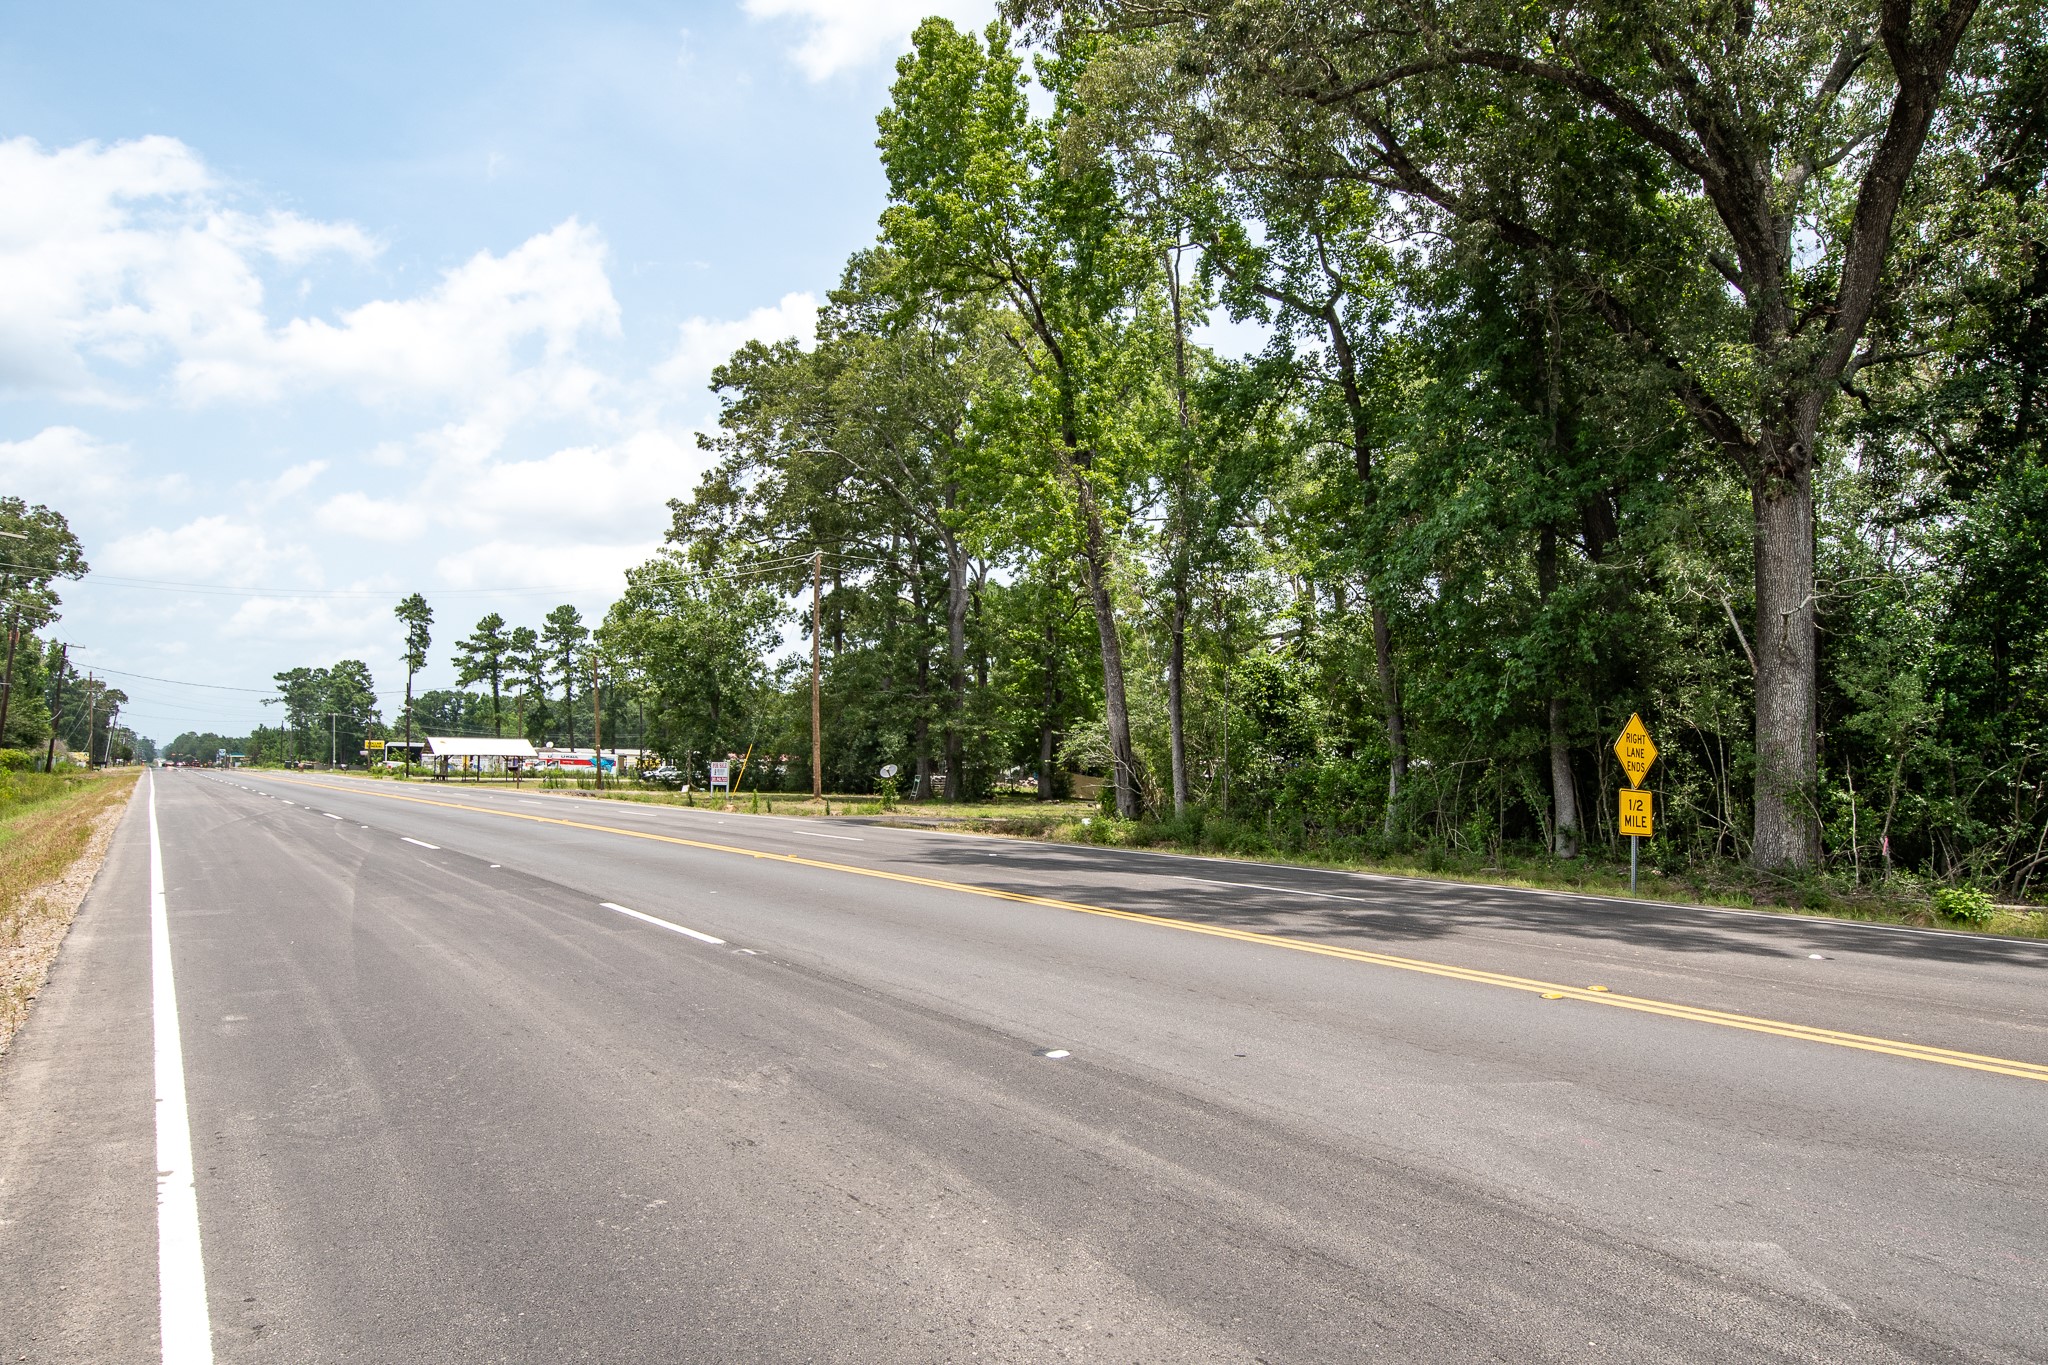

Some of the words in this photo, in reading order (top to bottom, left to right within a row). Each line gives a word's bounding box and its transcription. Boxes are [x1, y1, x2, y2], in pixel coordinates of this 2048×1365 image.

[1626, 733, 1645, 744] RIGHT
[1627, 747, 1644, 758] LANE
[1627, 761, 1645, 772] ENDS
[1629, 799, 1643, 811] 1/2
[1625, 815, 1647, 828] MILE
